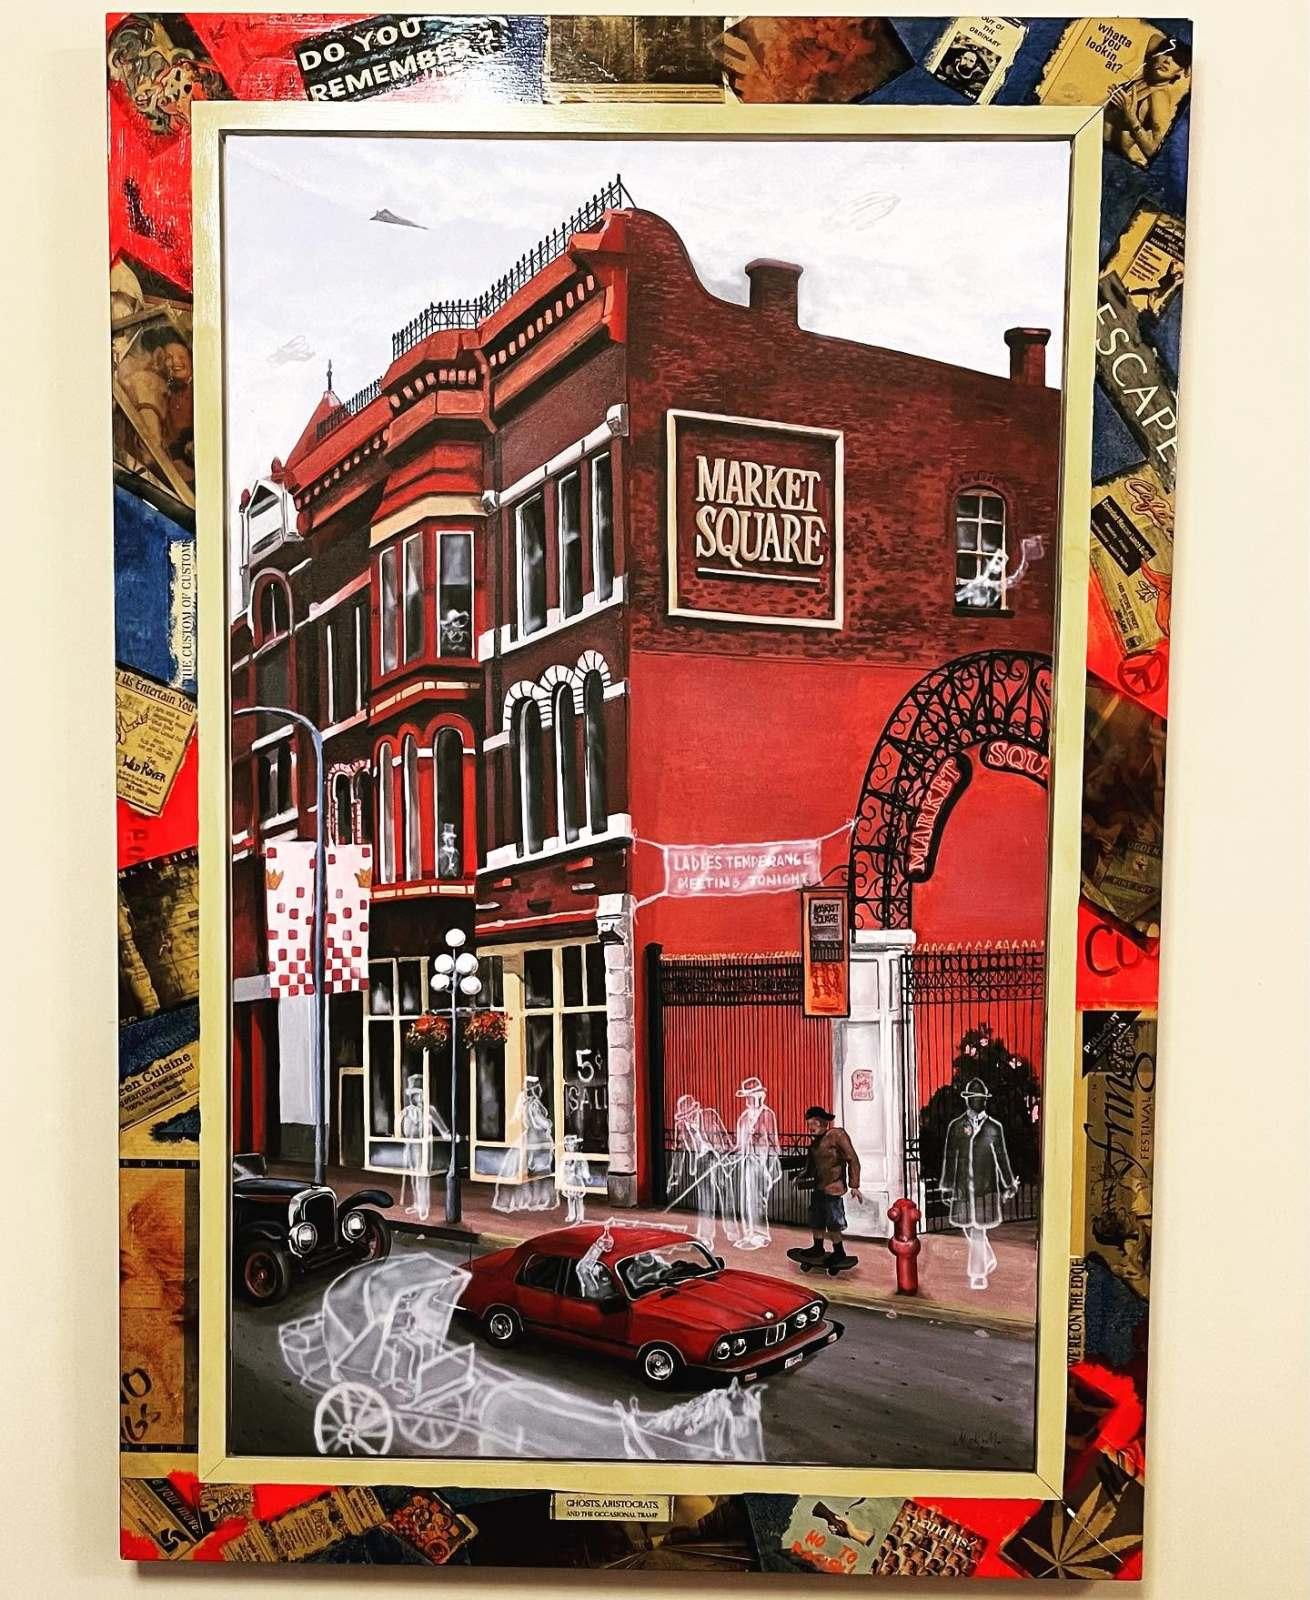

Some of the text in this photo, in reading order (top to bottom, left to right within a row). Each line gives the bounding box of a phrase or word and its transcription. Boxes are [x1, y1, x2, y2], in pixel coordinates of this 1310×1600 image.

[299, 17, 421, 71] DO YOU
[1085, 36, 1117, 62] lookin
[1101, 35, 1121, 51] you
[1105, 60, 1123, 74] at?
[696, 455, 821, 512] MARKET
[696, 505, 826, 568] SQUARE
[181, 592, 192, 608] OF
[181, 611, 192, 657] CUSTOM
[122, 673, 133, 687] Us
[135, 680, 176, 704] Entertain
[178, 697, 195, 713] You
[909, 758, 960, 872] MARKET
[673, 855, 722, 872] LADIES
[748, 873, 809, 886] TONIGHT
[142, 1053, 191, 1083] Cuisine
[1140, 1097, 1154, 1160] FESTIVAL
[1071, 1292, 1083, 1310] THE
[1070, 1314, 1082, 1330] ON
